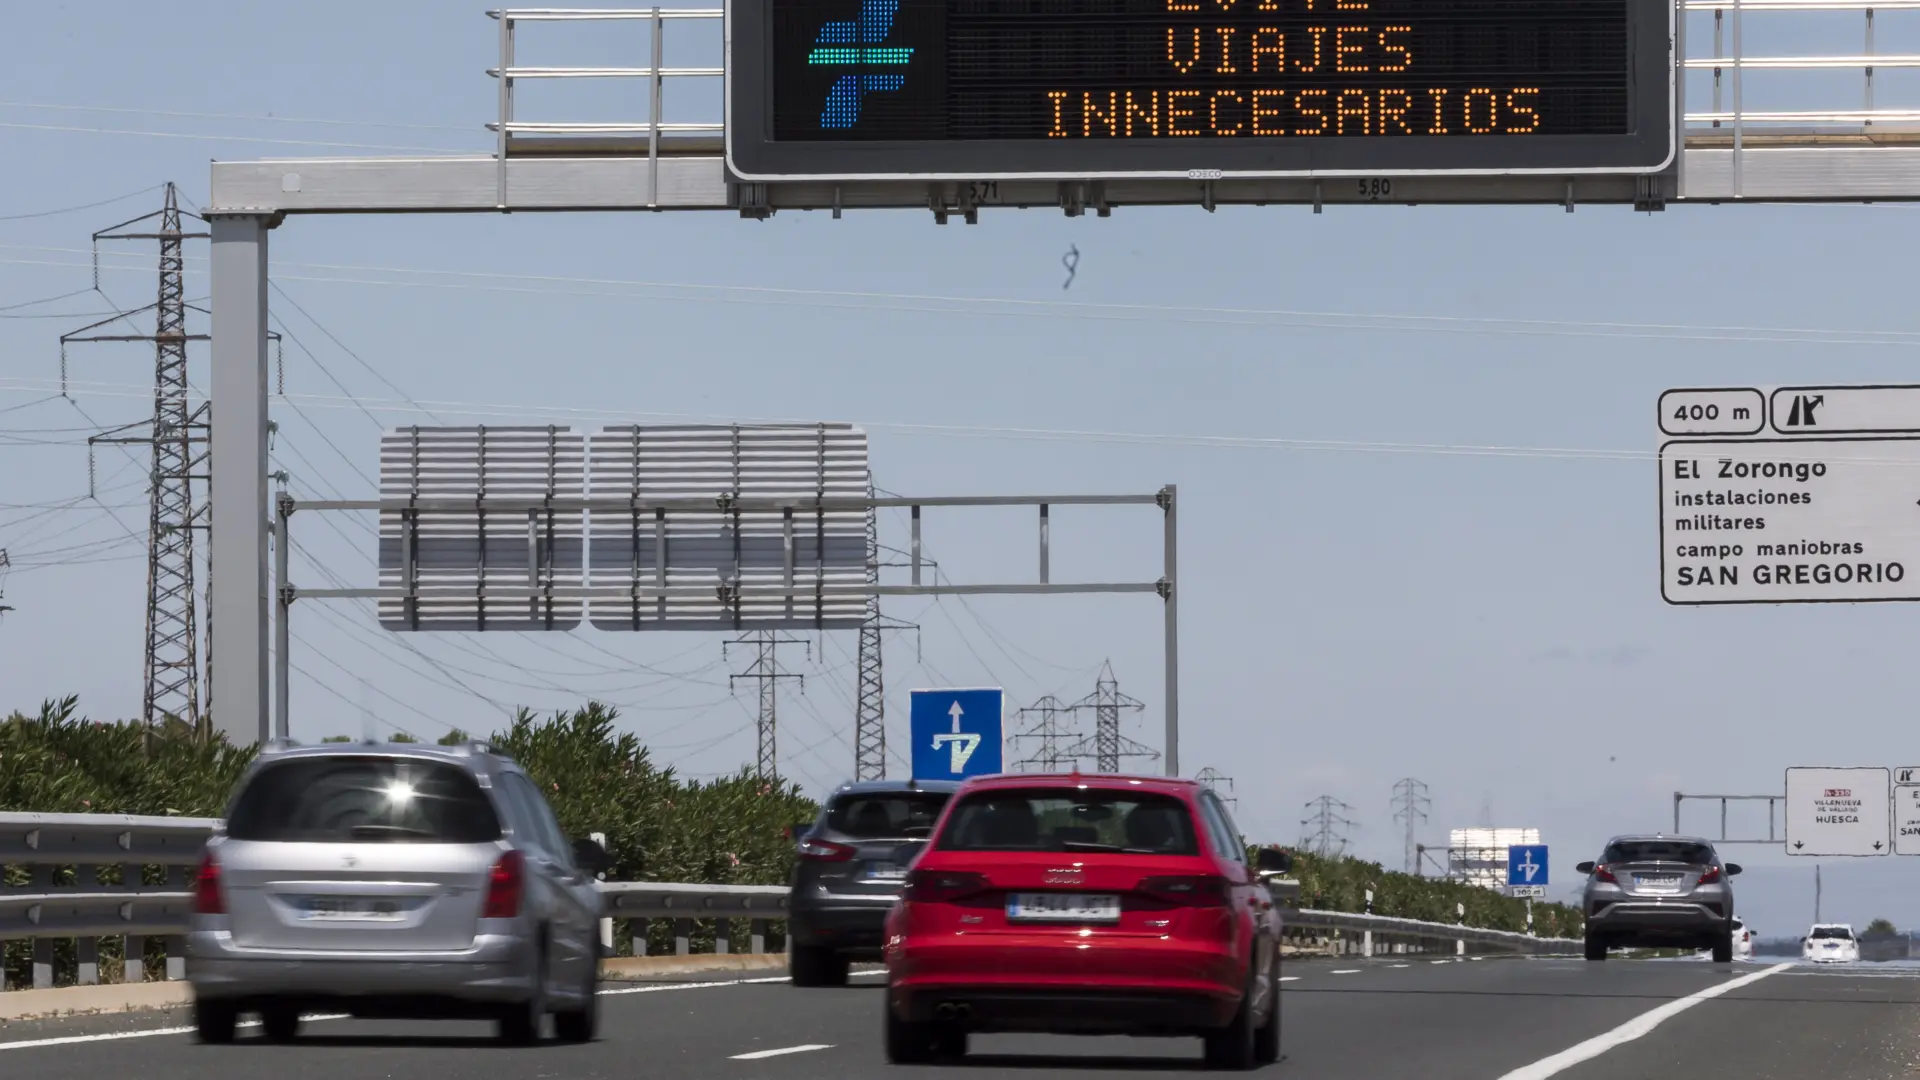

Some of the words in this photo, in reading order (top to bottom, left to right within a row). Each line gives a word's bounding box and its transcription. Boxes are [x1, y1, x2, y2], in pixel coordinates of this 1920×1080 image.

[1167, 26, 1412, 73] VIAJES
[1047, 88, 1540, 138] INNECESARIOS
[1358, 178, 1391, 197] 5,80
[1674, 404, 1719, 420] 400
[1733, 407, 1750, 420] m
[1675, 460, 1700, 479] El
[1718, 459, 1827, 482] Zorongo
[1675, 489, 1812, 506] instalaciones
[1675, 514, 1766, 530] militares
[1676, 544, 1743, 560] campo
[1757, 539, 1864, 556] maniobras
[1677, 566, 1738, 585] SAN
[1752, 562, 1905, 584] GREGORIO
[1815, 815, 1859, 824] HUESCA
